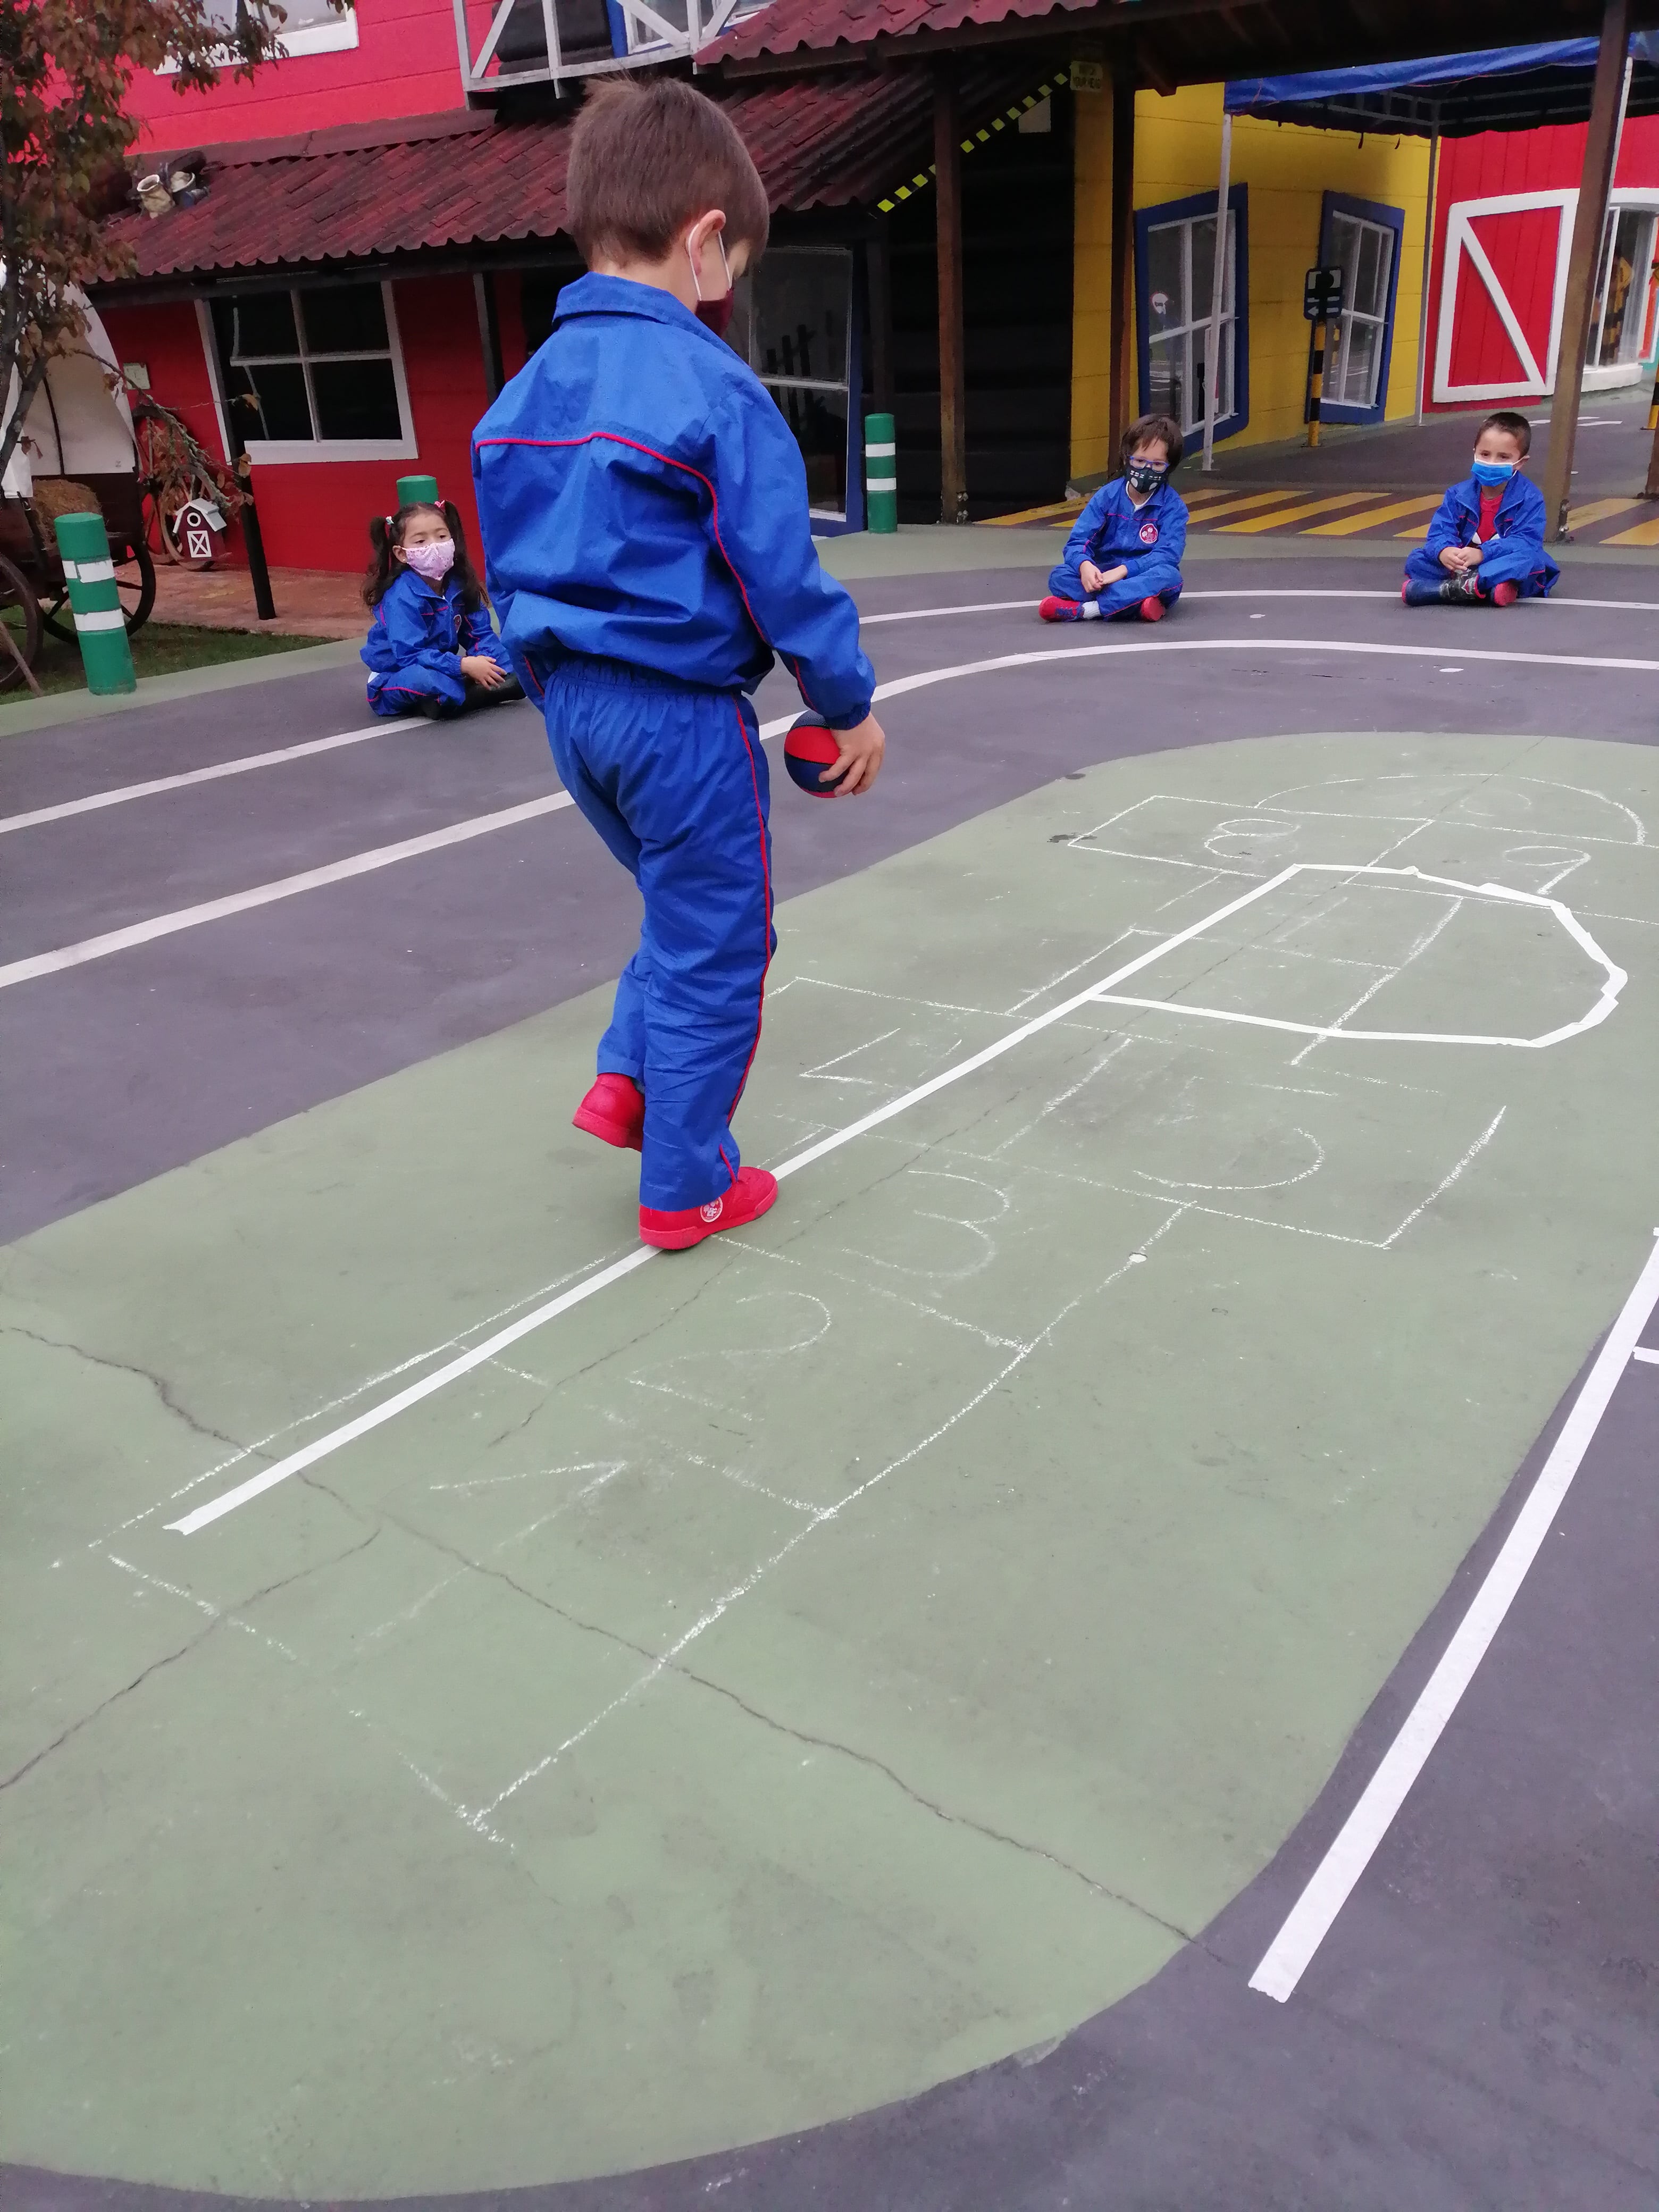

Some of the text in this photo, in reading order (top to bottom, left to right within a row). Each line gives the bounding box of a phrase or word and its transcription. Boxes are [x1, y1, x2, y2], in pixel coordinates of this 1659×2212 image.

[1502, 845, 1592, 895] 9
[839, 1170, 1010, 1279] 3
[624, 1290, 832, 1422] 2
